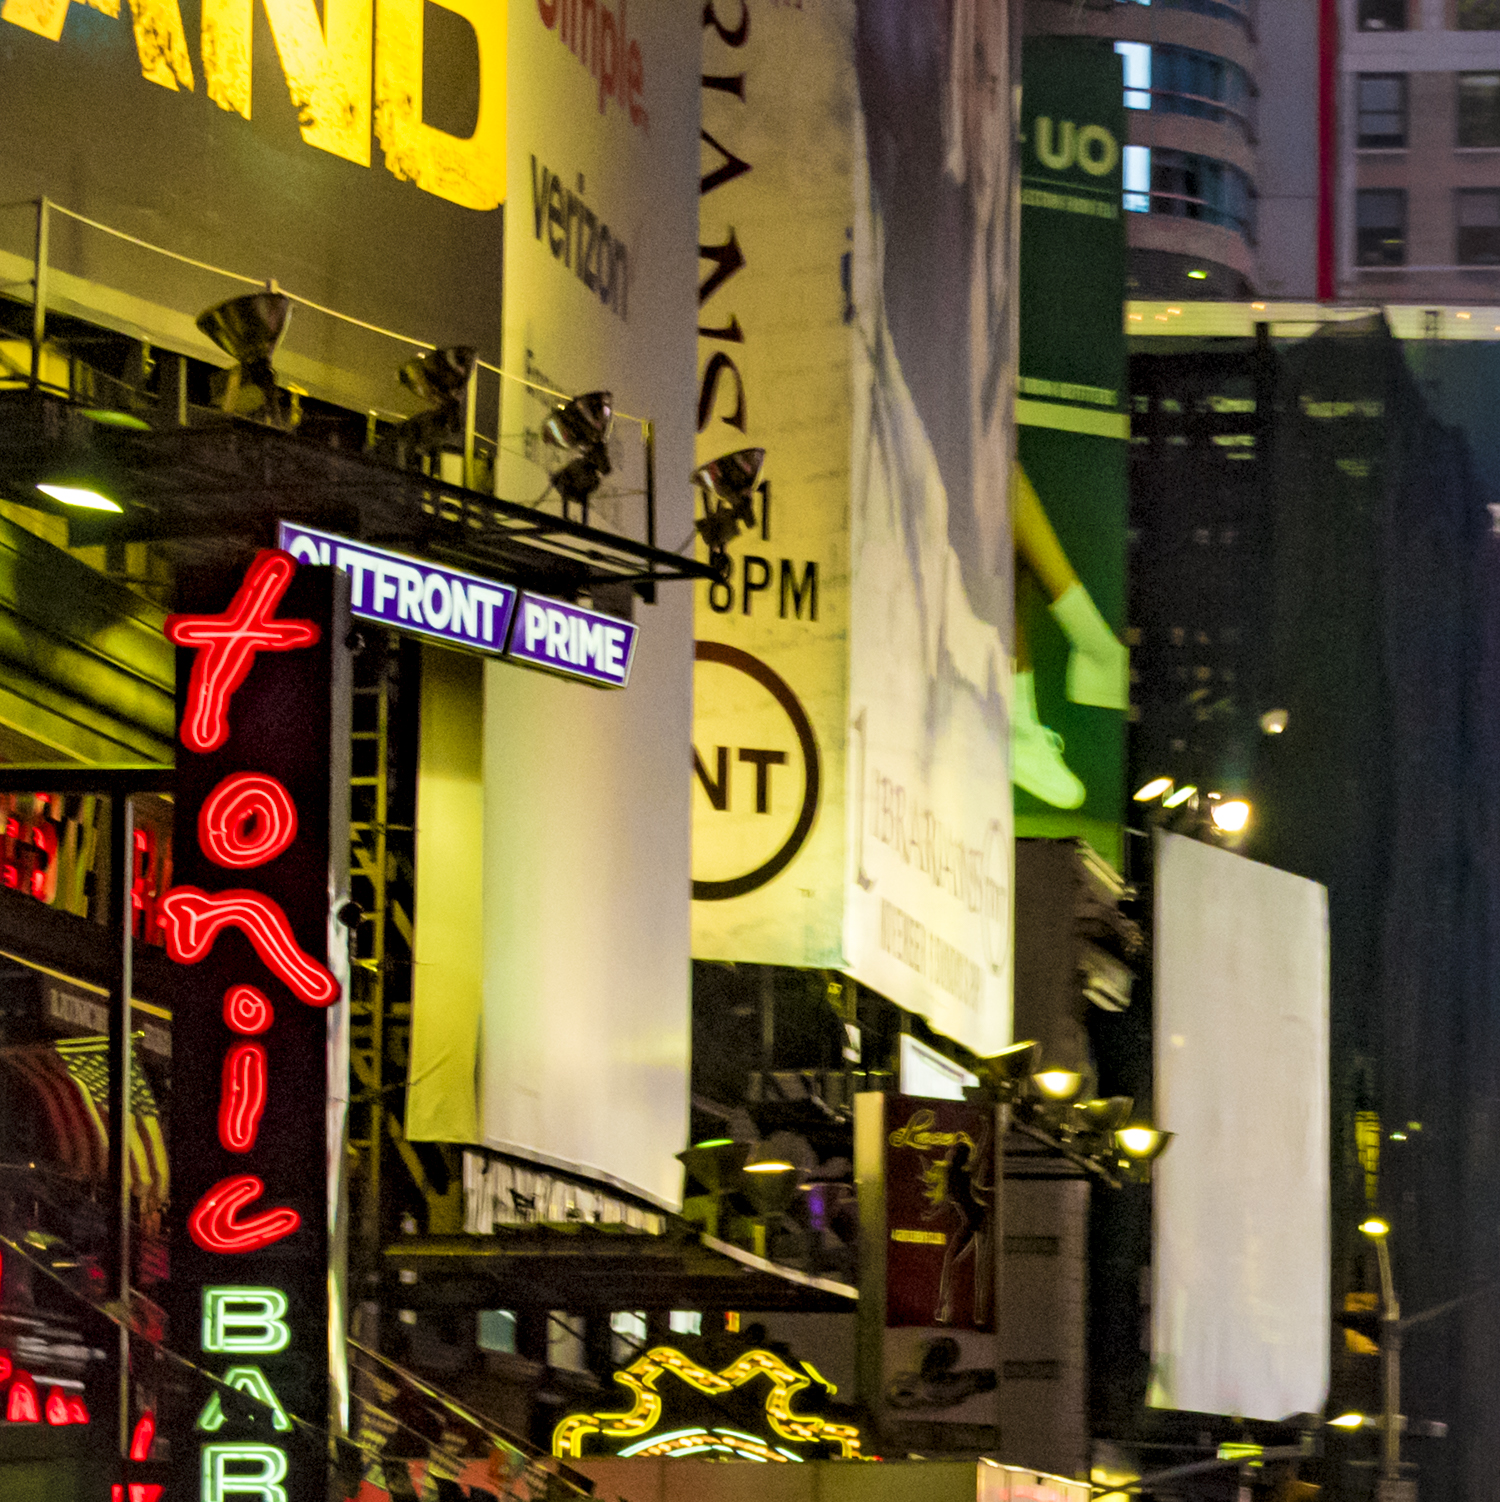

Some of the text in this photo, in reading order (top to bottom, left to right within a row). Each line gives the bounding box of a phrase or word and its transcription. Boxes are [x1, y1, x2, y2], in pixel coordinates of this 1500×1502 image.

[529, 153, 628, 323] verizon
[289, 534, 626, 678] TFRONT PRIME
[693, 744, 790, 815] NT
